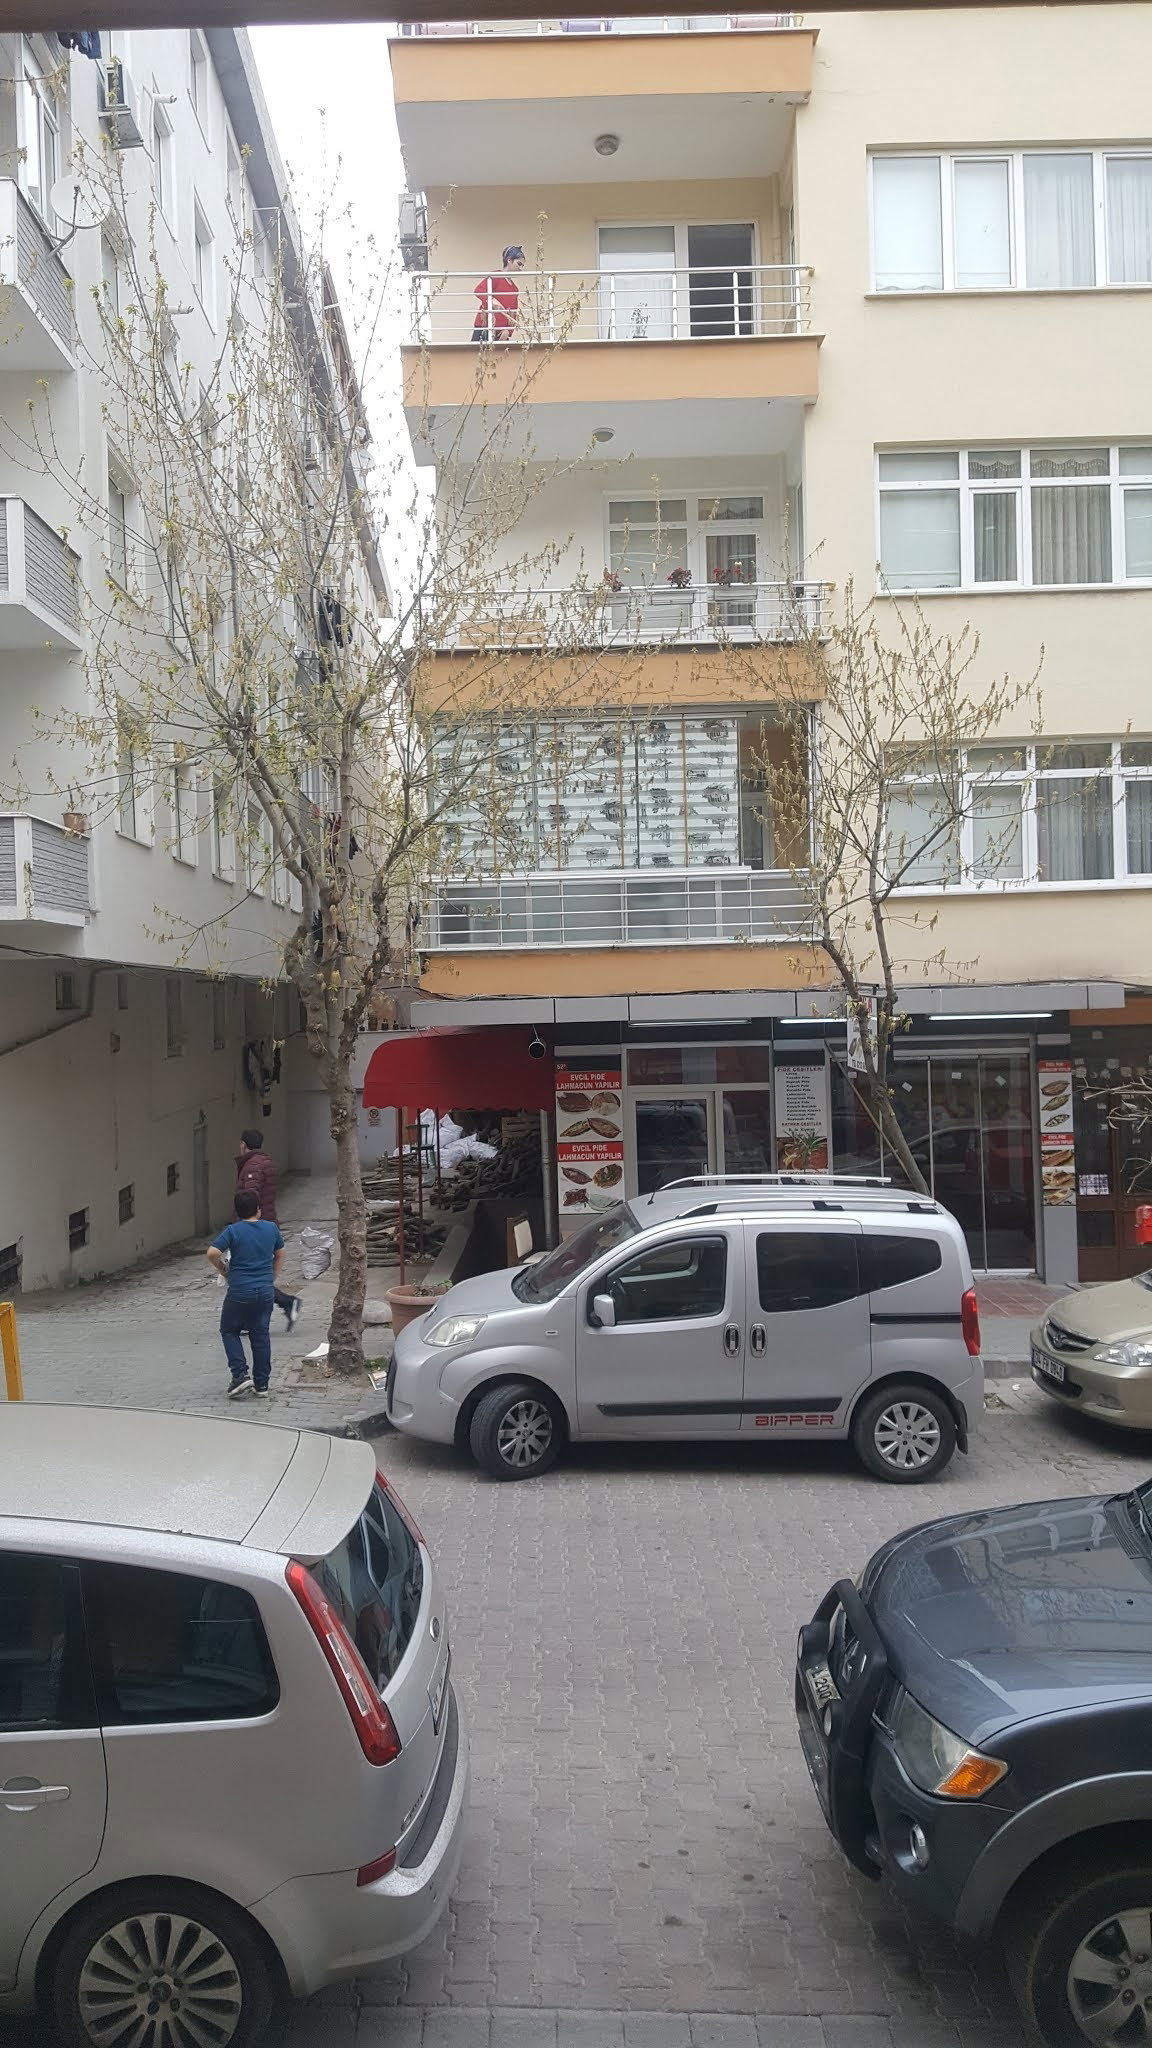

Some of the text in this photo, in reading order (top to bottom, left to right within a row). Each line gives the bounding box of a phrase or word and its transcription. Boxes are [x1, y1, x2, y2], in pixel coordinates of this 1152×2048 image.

[594, 1081, 620, 1089] YAPILIR
[558, 1152, 622, 1161] LAHMACUN YAPILIR
[755, 1414, 834, 1426] BIPPER
[815, 1678, 832, 1698] 200
